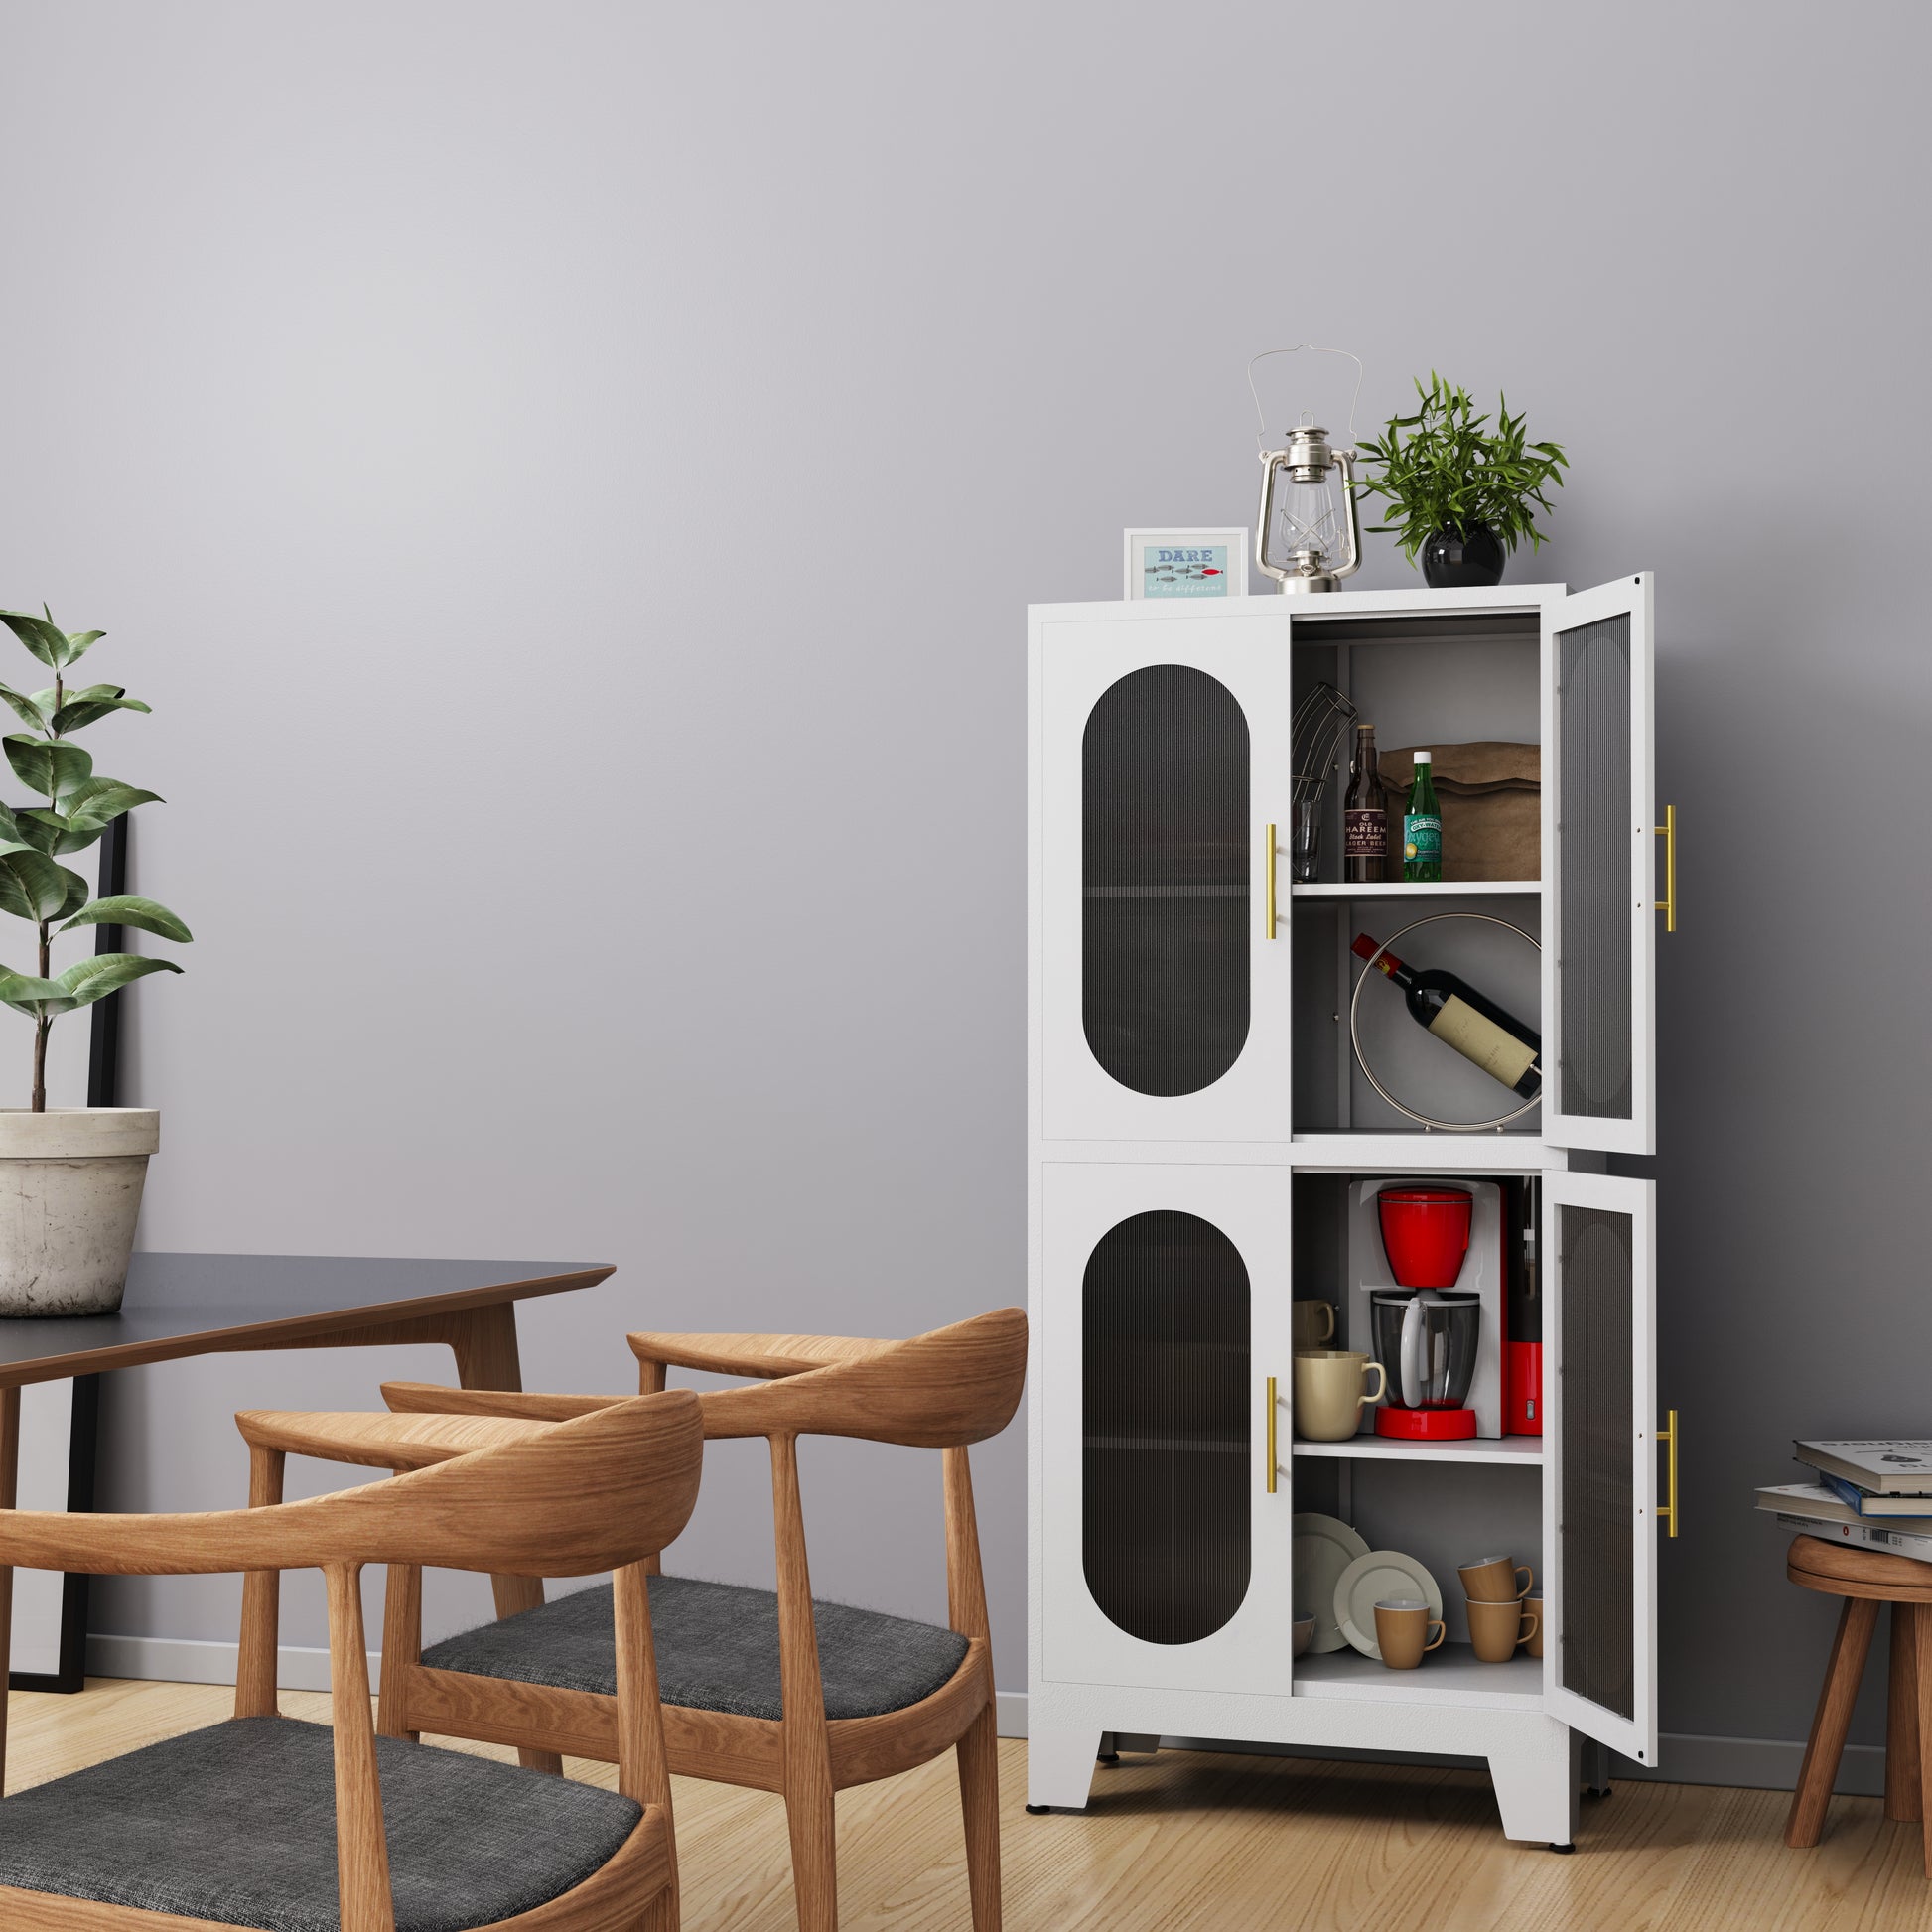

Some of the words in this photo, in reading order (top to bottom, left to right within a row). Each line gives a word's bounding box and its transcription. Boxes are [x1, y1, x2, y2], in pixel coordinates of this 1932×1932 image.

[1158, 550, 1213, 562] DARE
[1162, 583, 1173, 592] be
[1175, 584, 1222, 593] different
